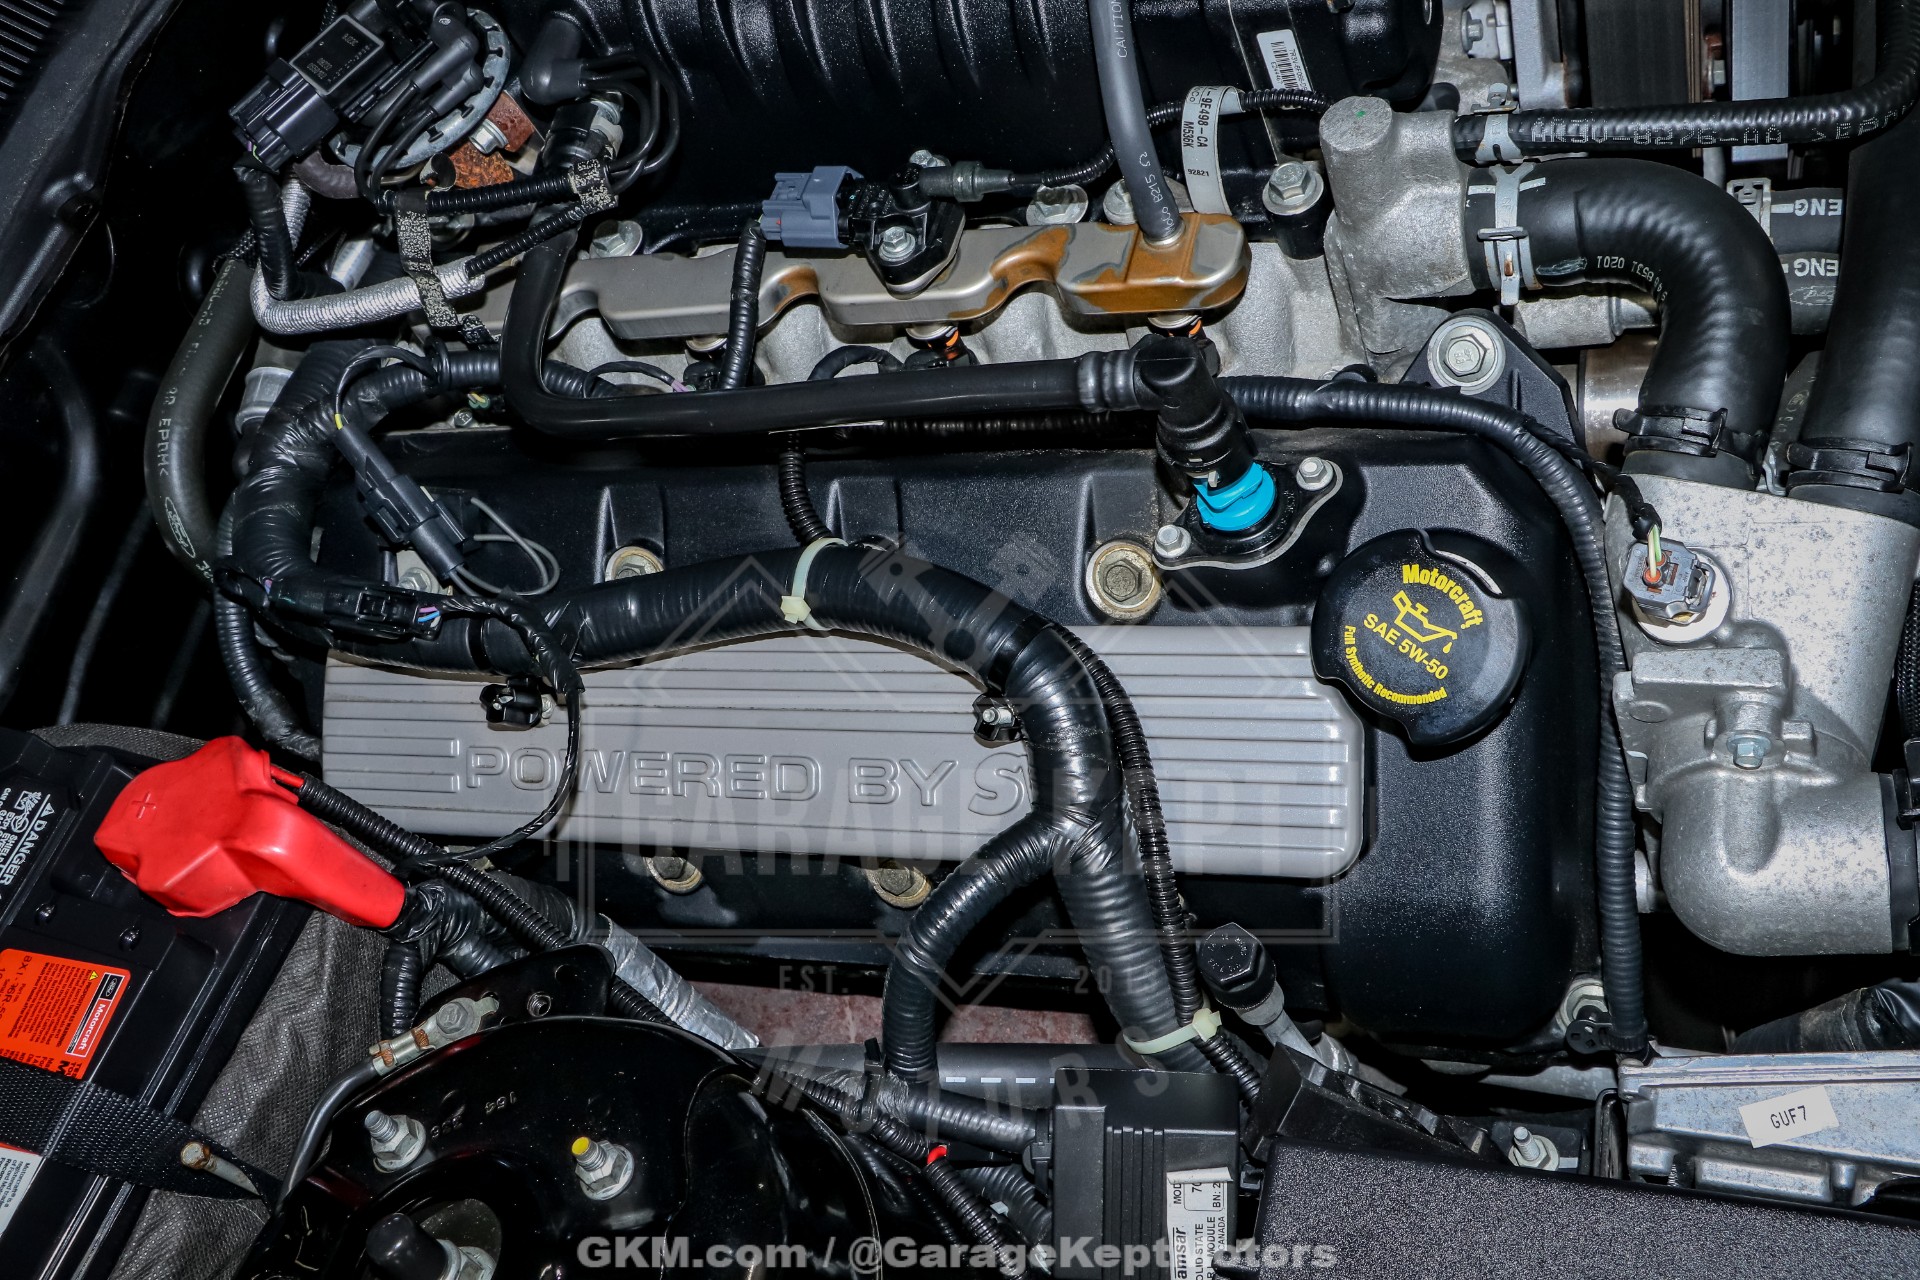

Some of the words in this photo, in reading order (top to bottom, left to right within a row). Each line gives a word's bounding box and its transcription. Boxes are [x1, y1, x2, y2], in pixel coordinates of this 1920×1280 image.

[1183, 120, 1195, 148] M536K
[1187, 168, 1210, 177] 92821
[1793, 198, 1842, 217] ENG
[1793, 257, 1840, 277] ENG
[1344, 625, 1357, 645] Full
[1363, 613, 1402, 645] SAE
[1398, 638, 1449, 680] 5W-50
[1345, 646, 1376, 689] Synthetic
[1373, 683, 1448, 705] Recommended
[466, 746, 819, 801] POWERED
[848, 756, 959, 807] BY
[967, 752, 1034, 816] S
[1, 819, 48, 886] DANGER
[78, 1003, 106, 1050] Motorcraft
[1770, 1105, 1807, 1129] GUF7
[1195, 1223, 1204, 1255] STATE
[1207, 1216, 1216, 1258] MODULE
